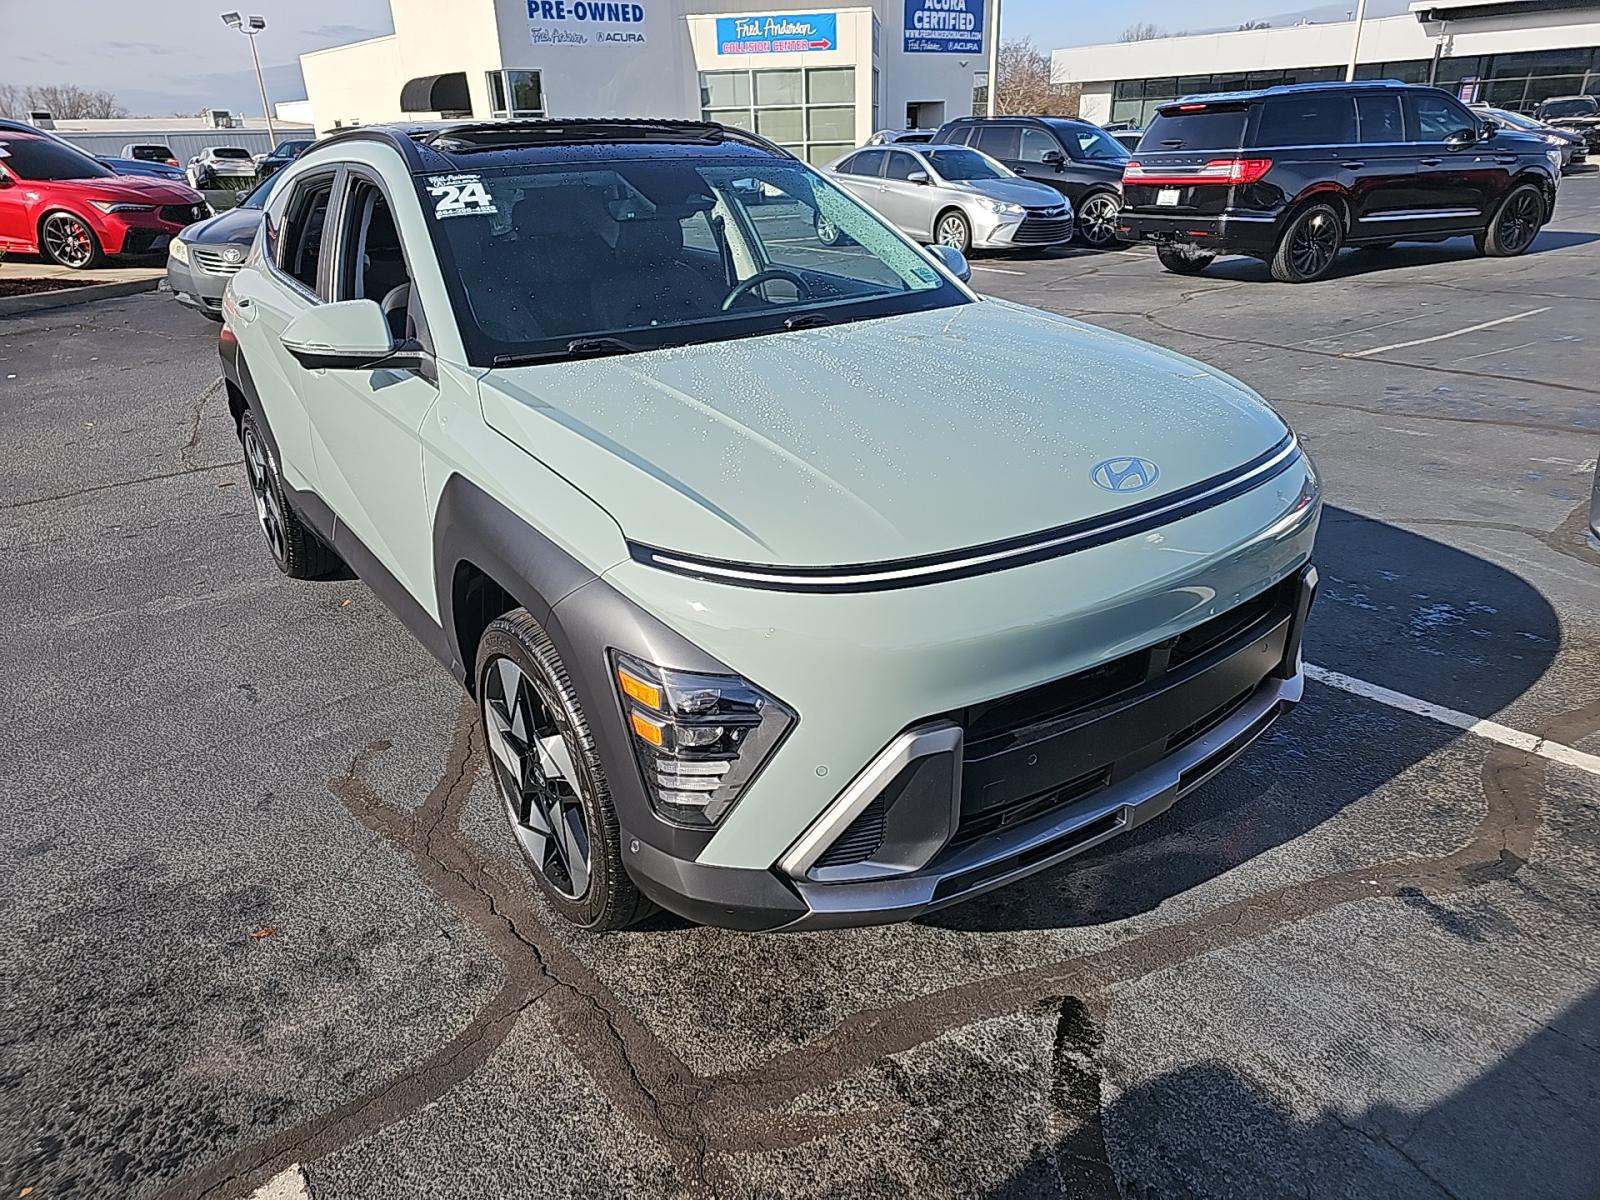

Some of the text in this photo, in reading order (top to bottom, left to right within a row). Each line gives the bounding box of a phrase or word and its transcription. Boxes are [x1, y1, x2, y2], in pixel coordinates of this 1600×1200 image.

[527, 0, 645, 22] PRE-OWNED
[924, 0, 966, 11] ACURA
[735, 17, 816, 38] Fred Anderson
[913, 11, 975, 30] CERTIFIED
[605, 32, 645, 42] ACURA
[722, 39, 809, 54] COLLISION CENTER
[953, 43, 978, 51] ACURA
[426, 182, 492, 211] 24
